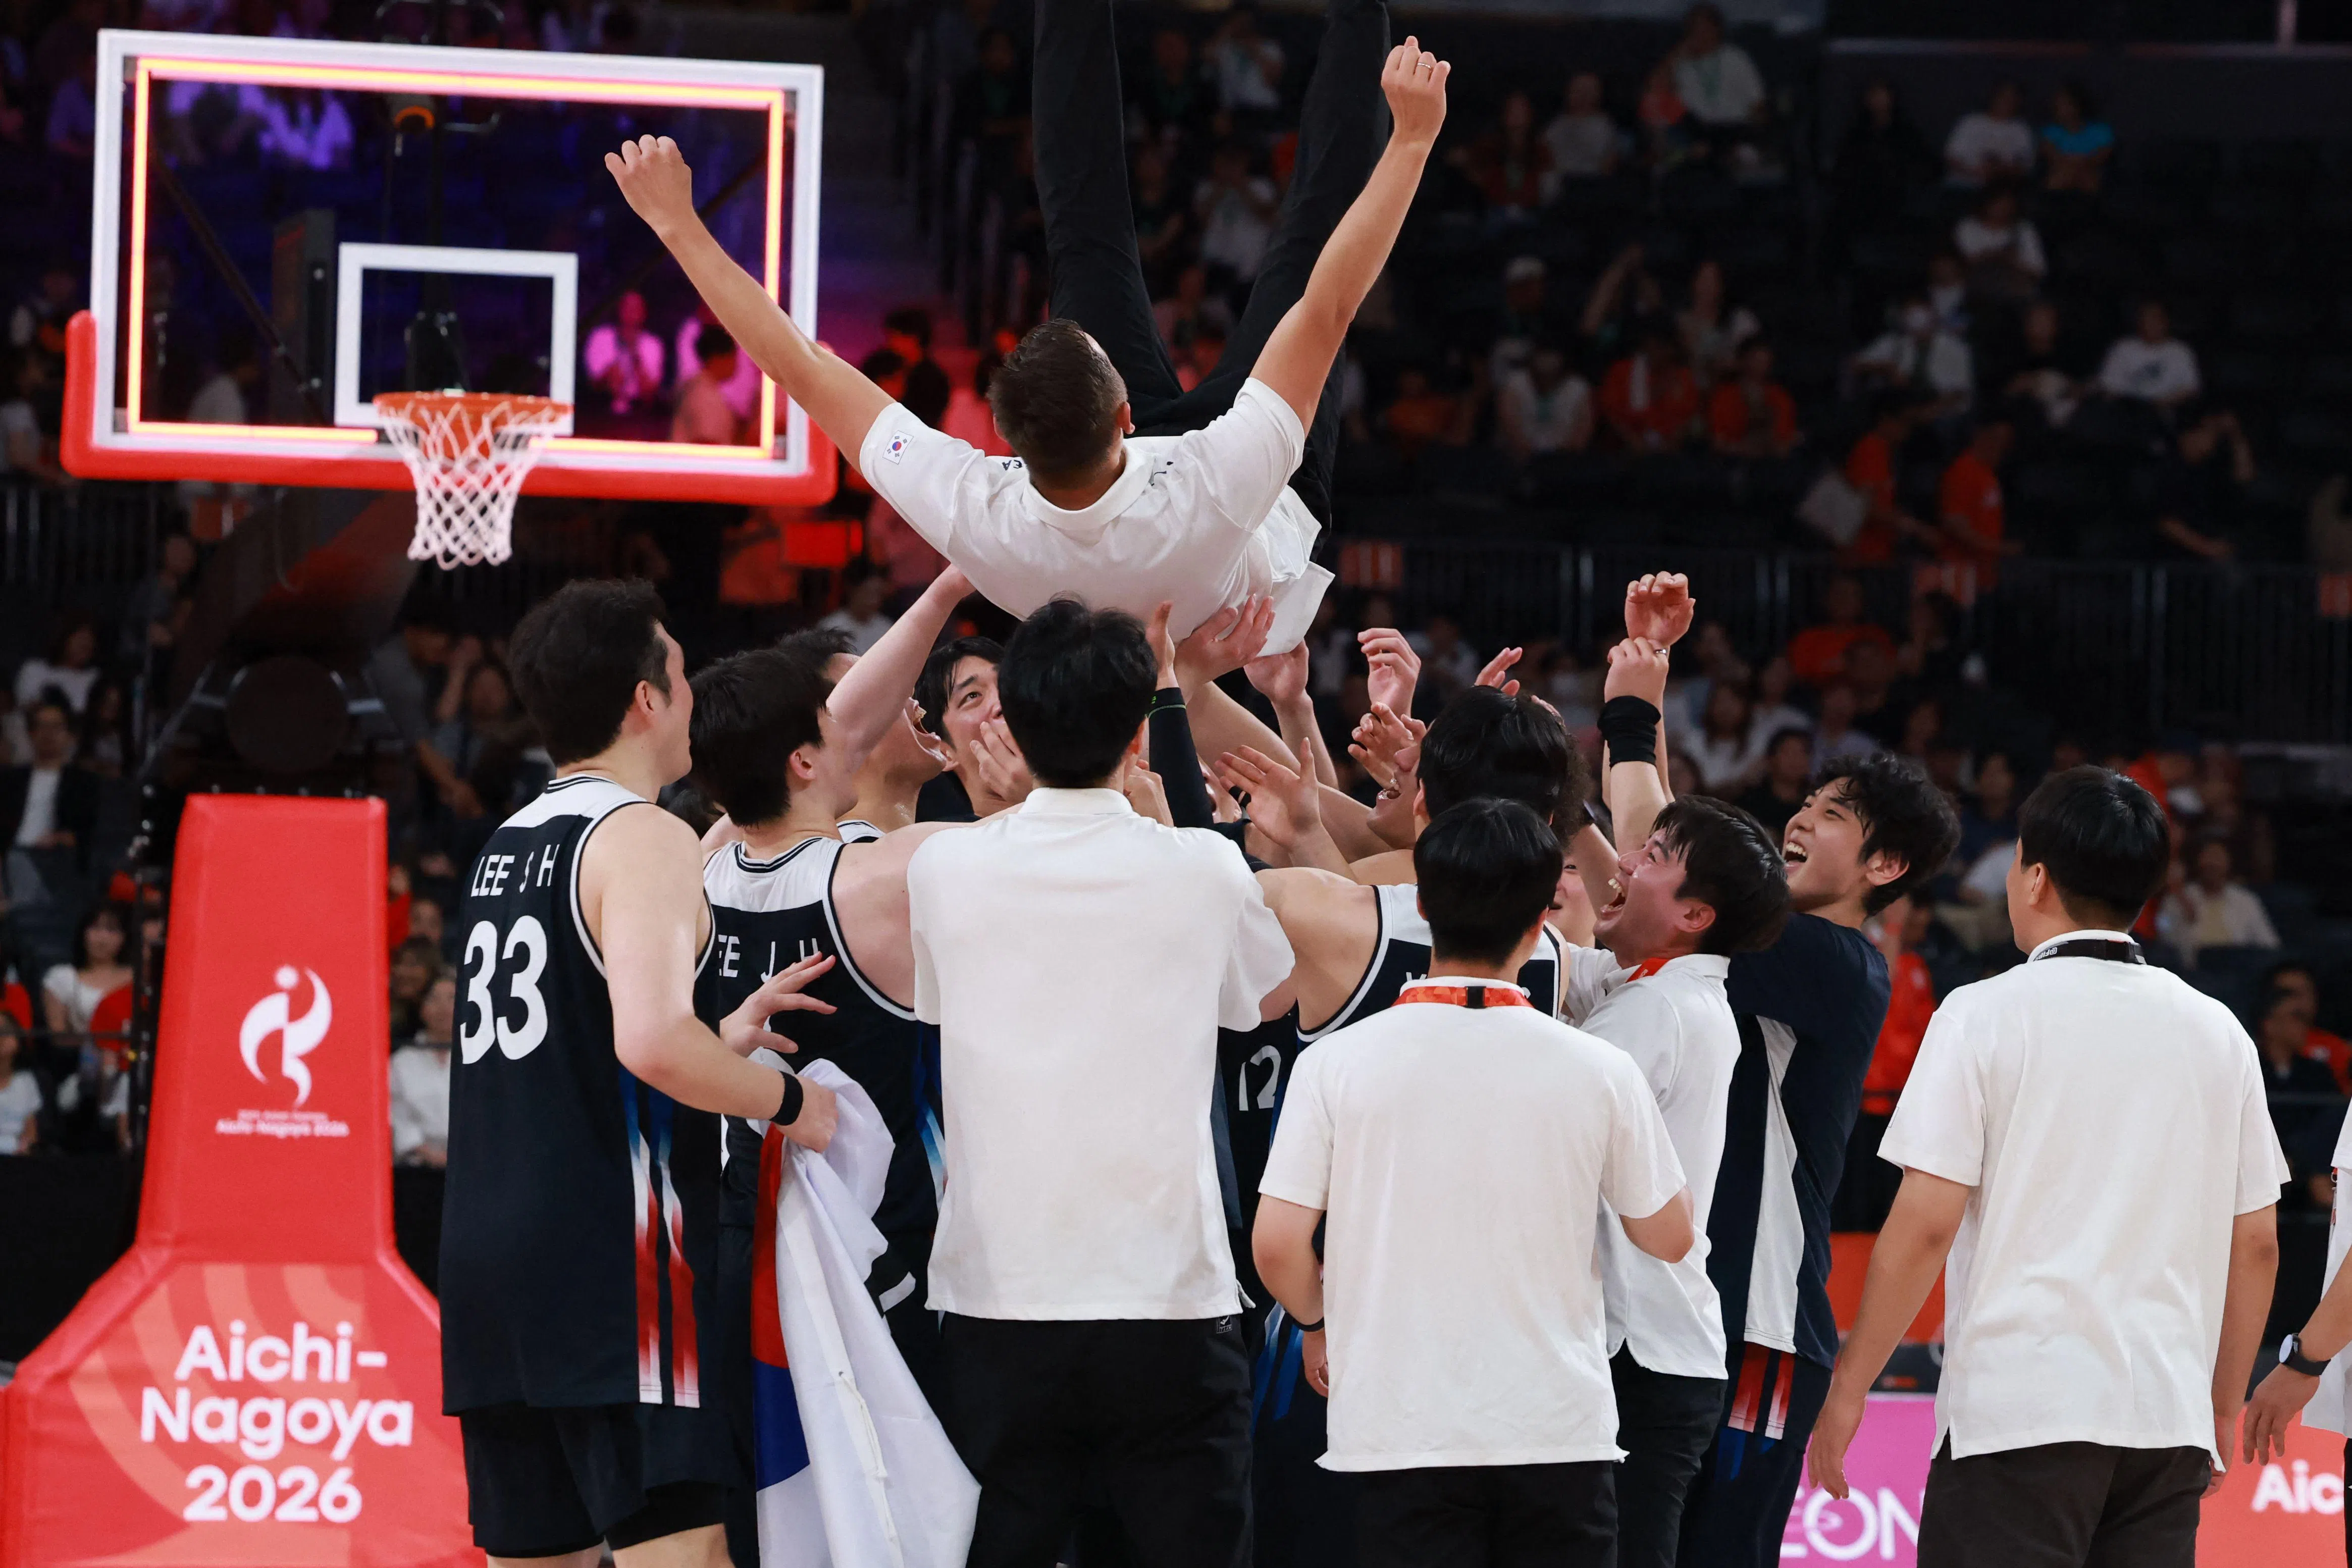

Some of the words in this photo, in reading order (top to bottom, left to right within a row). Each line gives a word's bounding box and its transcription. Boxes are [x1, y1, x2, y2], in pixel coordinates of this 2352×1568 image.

[1002, 459, 1023, 471] EA
[471, 855, 515, 897] LEE
[519, 851, 534, 893] S
[536, 844, 560, 887] H
[460, 915, 548, 1065] 33
[1238, 1044, 1282, 1111] 12
[174, 1319, 387, 1383] Aichi-
[140, 1386, 414, 1461] Nagoya
[182, 1465, 362, 1524] 2026
[2251, 1458, 2345, 1515] Aic
